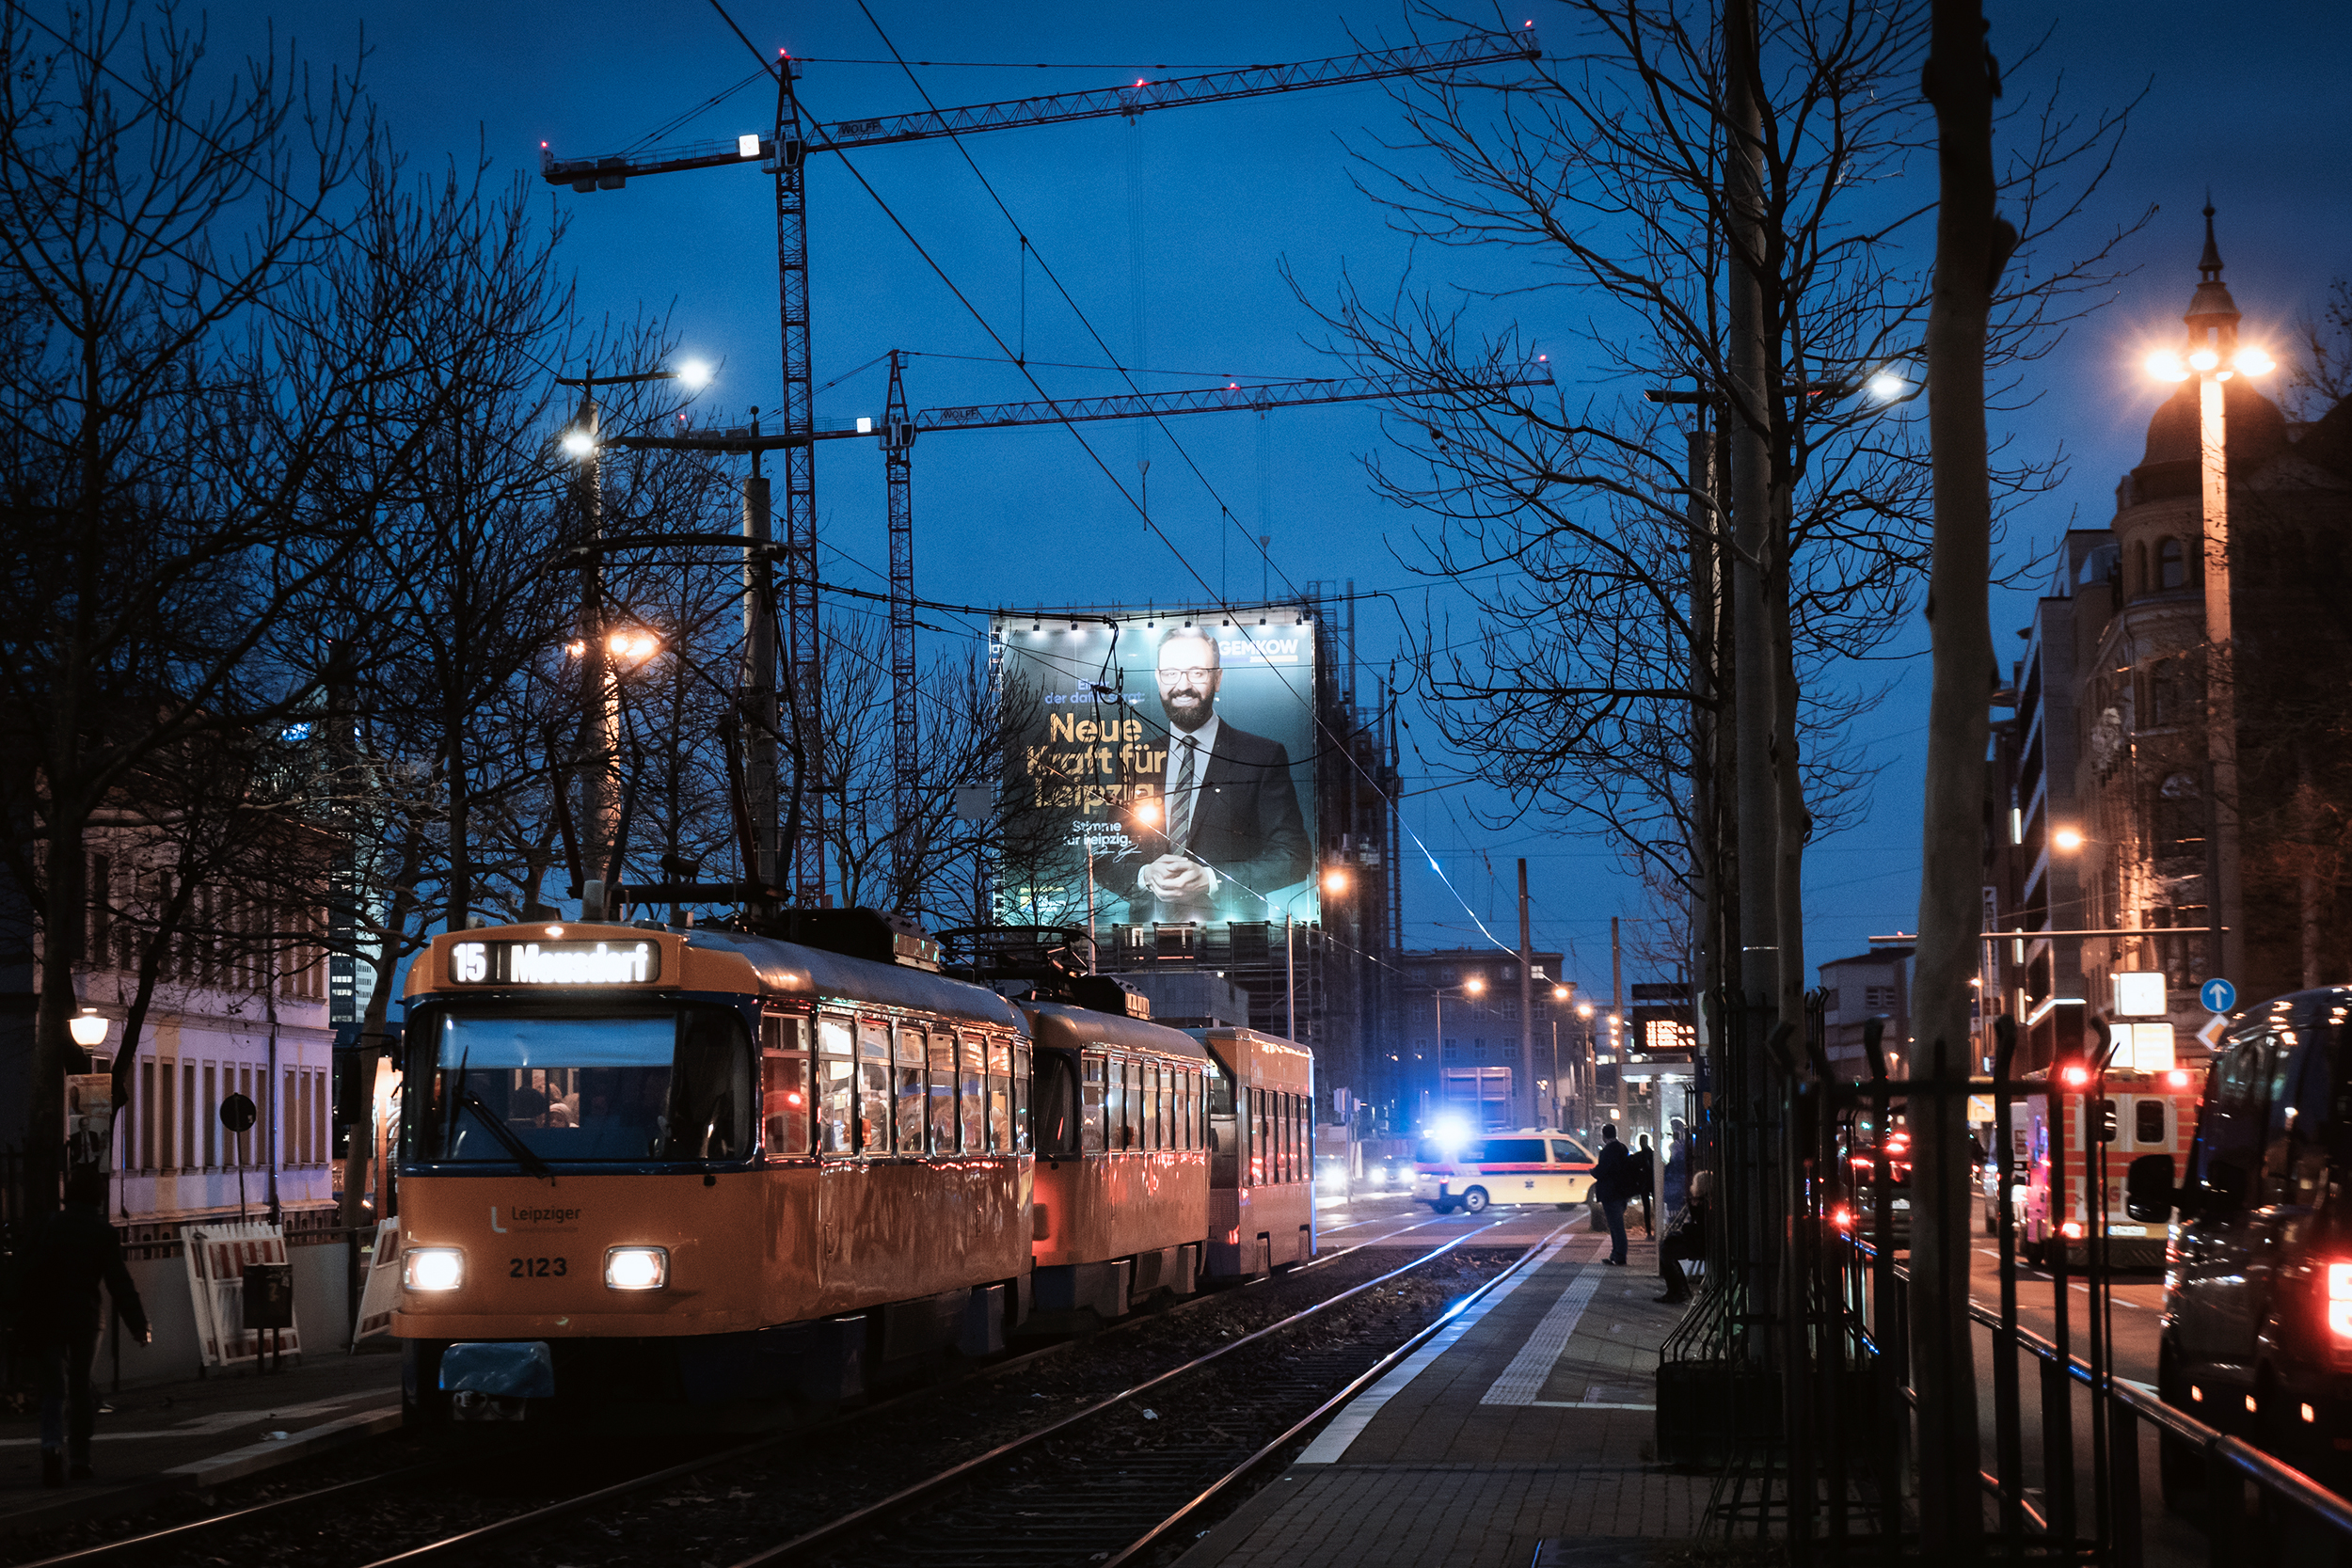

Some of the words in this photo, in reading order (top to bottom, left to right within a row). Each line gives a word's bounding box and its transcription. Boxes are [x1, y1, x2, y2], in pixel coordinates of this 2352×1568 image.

[841, 122, 879, 135] WOLFF
[944, 409, 977, 419] WOLFF
[1218, 639, 1298, 657] GEMKOW
[1044, 691, 1067, 705] der
[1070, 691, 1104, 704] daf
[1050, 712, 1142, 743] Neue
[1026, 744, 1113, 775] Kraft
[1120, 743, 1168, 774] für
[1073, 819, 1122, 832] Stimme
[1083, 832, 1133, 847] Leipzig.
[453, 942, 487, 982] 15
[512, 1206, 580, 1224] Leipziger
[509, 1257, 567, 1278] 2123
